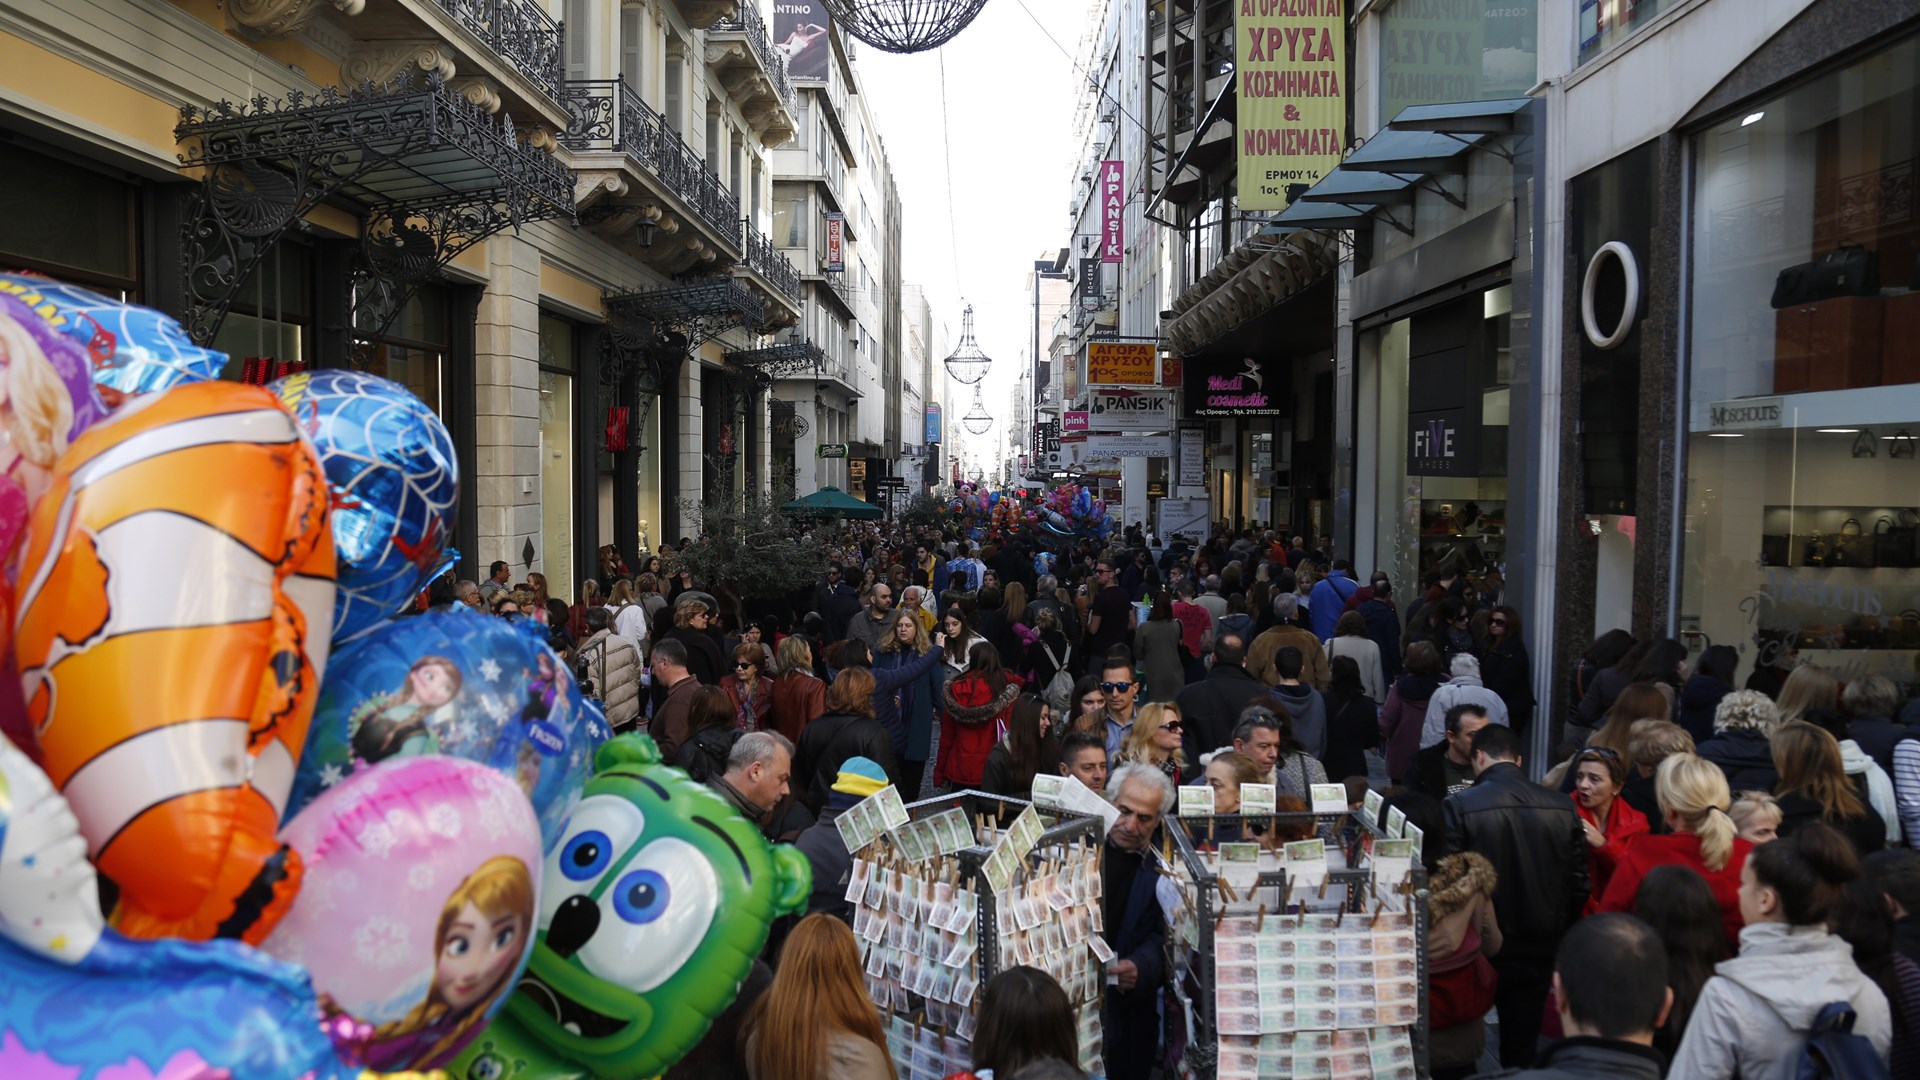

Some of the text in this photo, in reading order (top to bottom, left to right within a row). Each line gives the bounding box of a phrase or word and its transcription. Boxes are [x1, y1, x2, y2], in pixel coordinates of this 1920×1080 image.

[1248, 27, 1335, 62] ΧΡΥΣΑ
[1243, 71, 1340, 98] ΚΟΣΜΗΜΑΤΑ
[1283, 104, 1301, 121] &
[1244, 129, 1340, 156] ΝΟΜΙΣΜΑΤΑ
[1265, 170, 1319, 180] ΕΡΜΟΥ 14
[1260, 185, 1279, 196] 1ος
[1096, 345, 1148, 355] ΑΓΟΡΑ
[1090, 356, 1154, 366] ΧΡΥΣΟΥ
[1090, 367, 1119, 383] 1ος
[1207, 375, 1243, 390] Medi
[1207, 392, 1268, 407] cosmetic
[1065, 416, 1085, 426] pink
